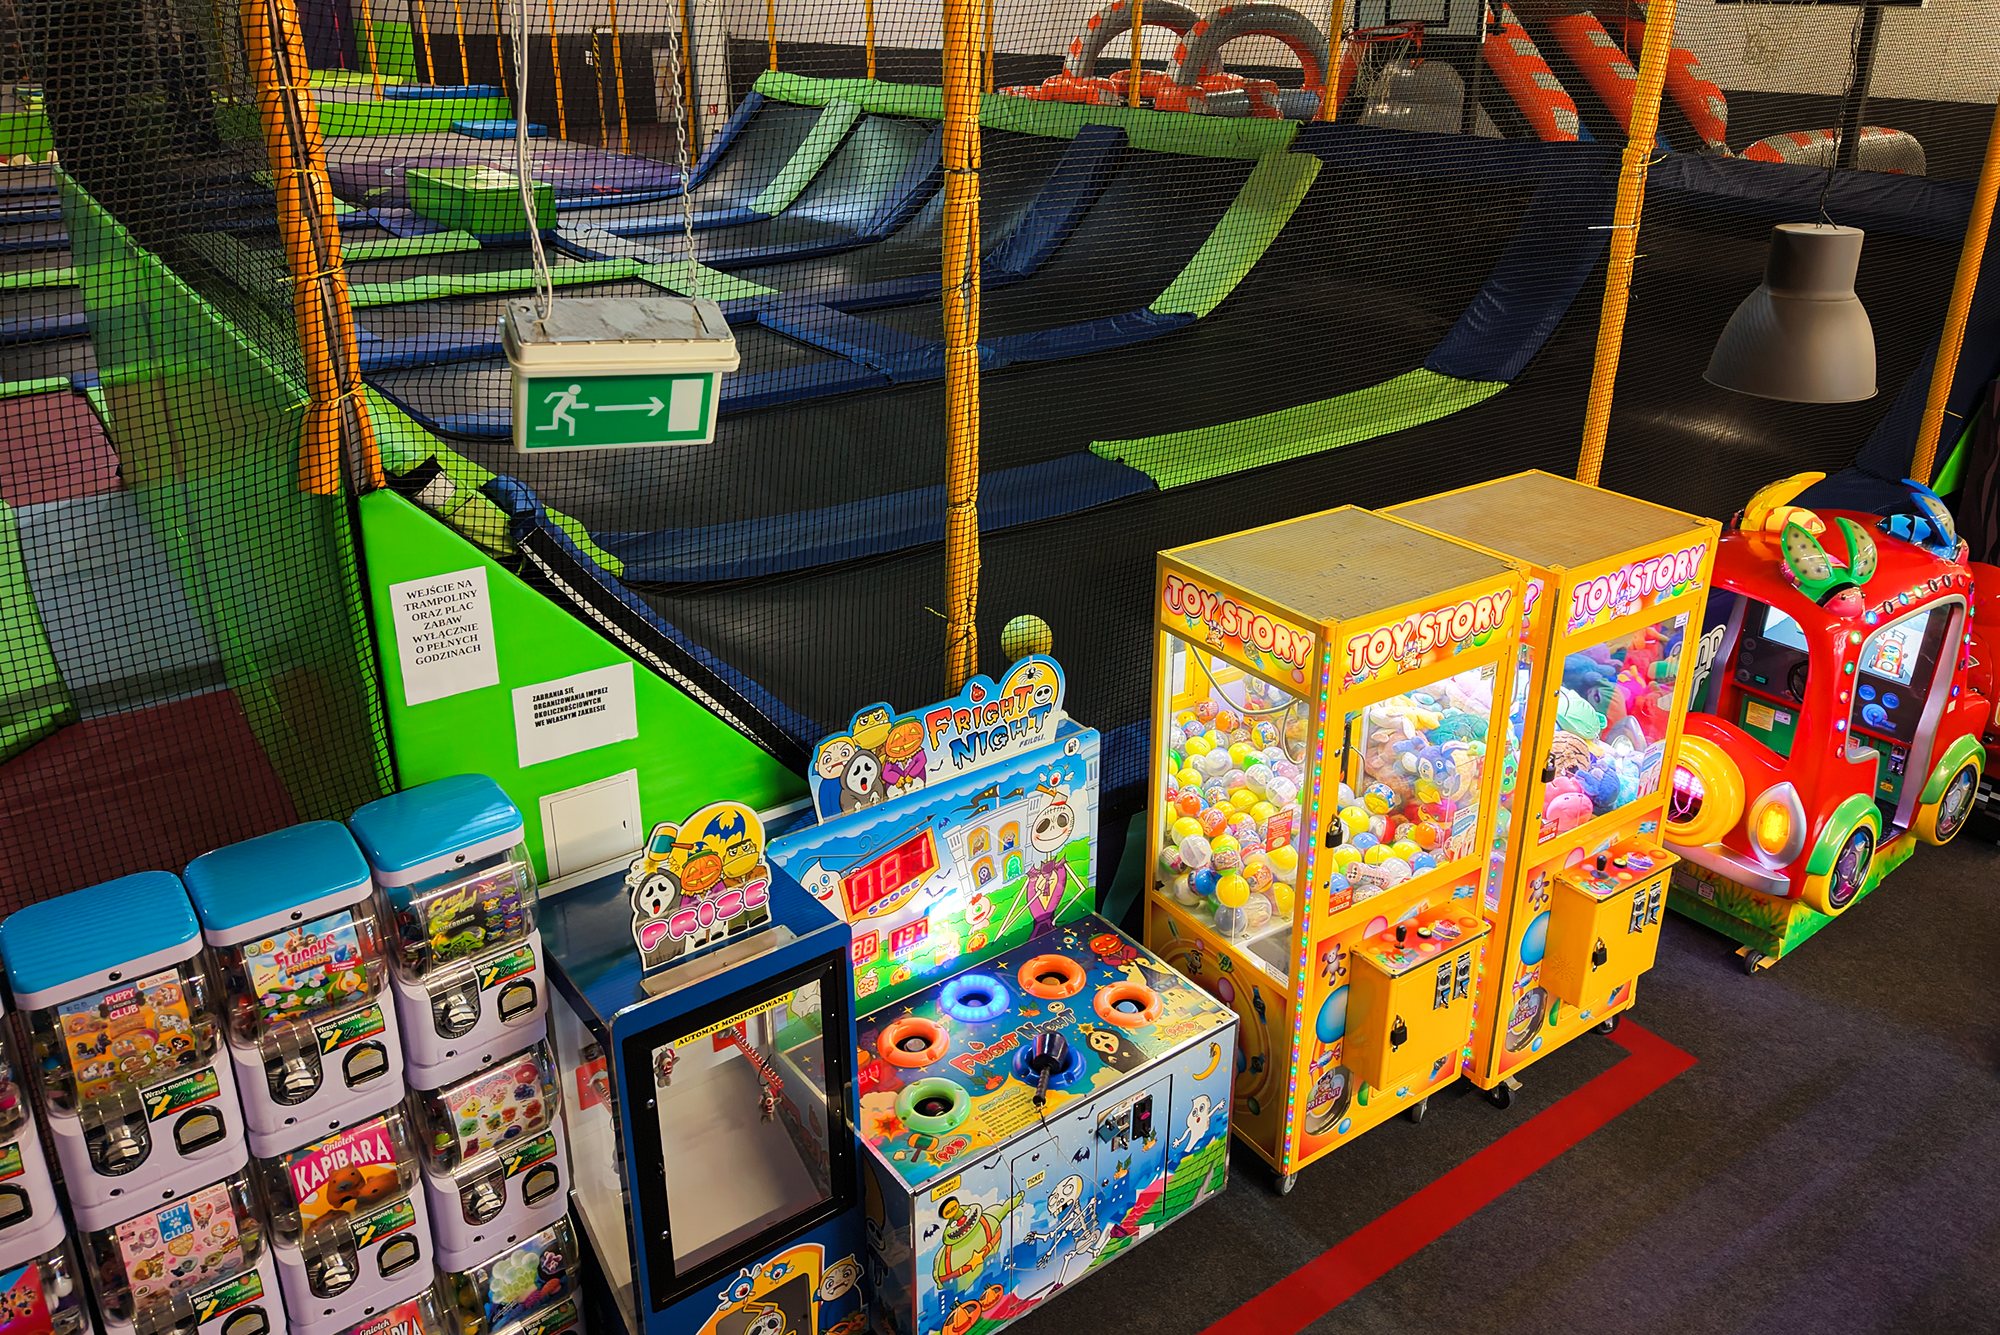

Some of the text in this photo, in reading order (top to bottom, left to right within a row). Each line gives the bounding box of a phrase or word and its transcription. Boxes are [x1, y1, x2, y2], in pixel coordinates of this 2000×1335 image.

[406, 580, 473, 600] WEJŚCIE NA
[1569, 542, 1707, 622] TOY STORY
[403, 589, 478, 612] TRAMPOLINY
[411, 601, 474, 622] ORAZ PLAC
[412, 622, 479, 644] WYŁĄCZNIE
[423, 615, 462, 631] ZABAW
[1165, 574, 1314, 670] TOY STORY
[1346, 588, 1513, 677] TOY STORY
[415, 633, 478, 654] O PEŁNYCH
[415, 644, 482, 666] GODZINACH
[532, 686, 575, 703] ZABRANIA SIĘ
[533, 686, 608, 711] ORGANIZOWANIA IMPREZ
[534, 697, 602, 720] OKOLICZNOŚCIOWYCH
[534, 704, 606, 728] WE WŁASNYM ZAKRESIE
[925, 683, 1034, 751] FRIGHT
[949, 702, 1052, 770] NIGHT
[867, 879, 921, 915] SCORE
[640, 878, 769, 952] PRIZE
[285, 955, 332, 976] FRIENDS
[104, 988, 135, 1006] PUPPY
[109, 1004, 139, 1020] CLUB
[316, 1012, 361, 1034] Wrzuć monetę
[678, 994, 790, 1046] AUTOMAT MONITOROWANY
[1015, 1007, 1077, 1042] NIGHT
[949, 1032, 1020, 1076] FRIGHT
[144, 1077, 194, 1100] Wrzuć monetę
[293, 1133, 392, 1198] KAPIBARA
[1027, 1171, 1045, 1186] TICKET
[157, 1204, 188, 1222] KITTY
[945, 1204, 958, 1216] SELECT
[163, 1223, 194, 1243] CLUB
[192, 1281, 239, 1304] Wrzuć monetę
